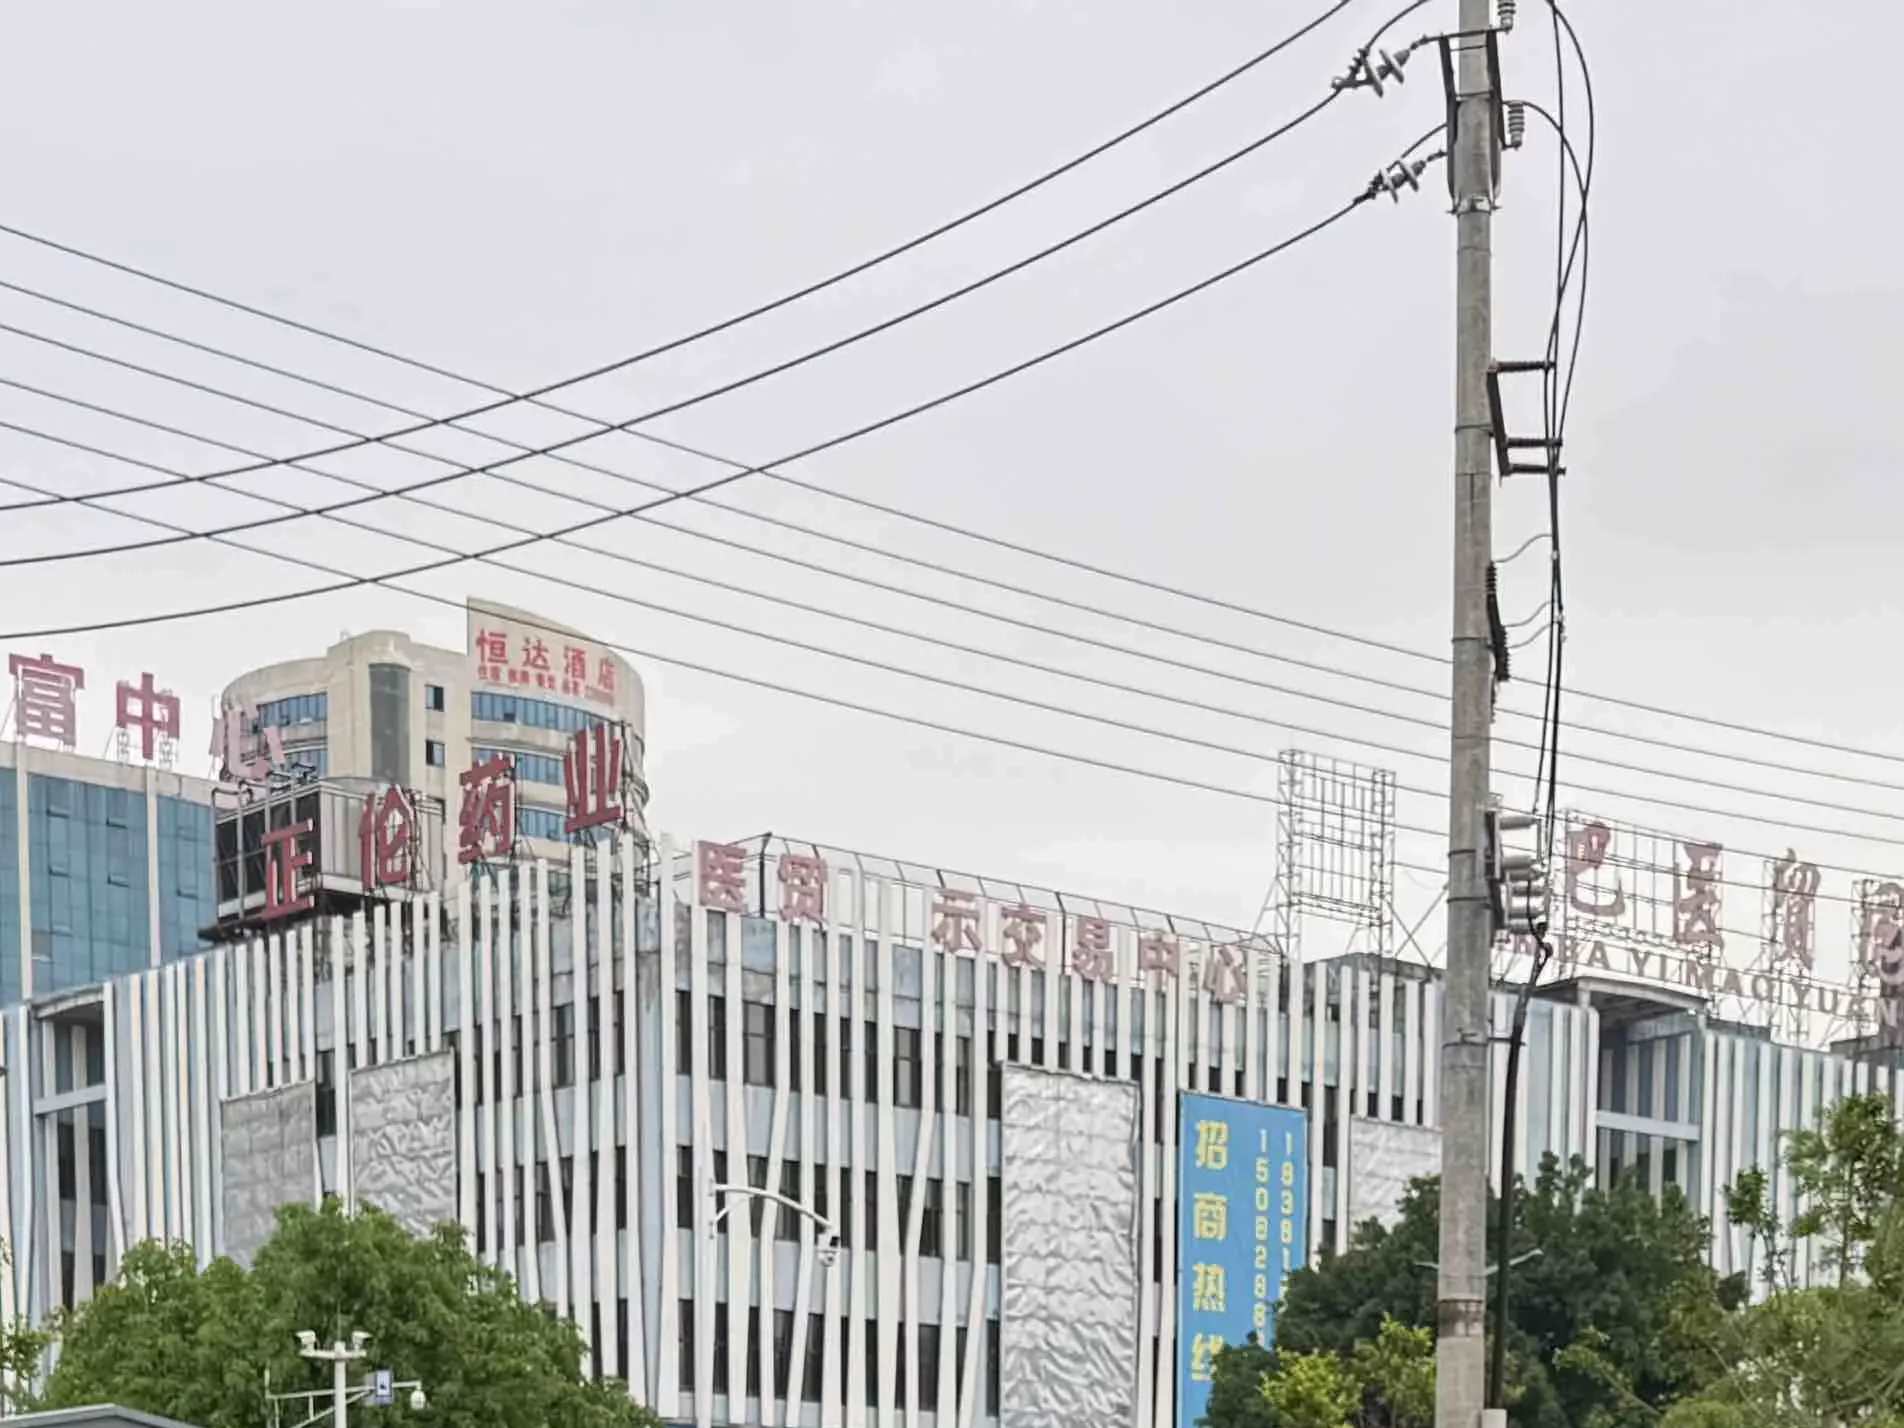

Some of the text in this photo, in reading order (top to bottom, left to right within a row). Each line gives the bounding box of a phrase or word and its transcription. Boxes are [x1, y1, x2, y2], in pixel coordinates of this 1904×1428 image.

[476, 628, 616, 691] 恒达酒店
[261, 721, 624, 919] 正伦药业
